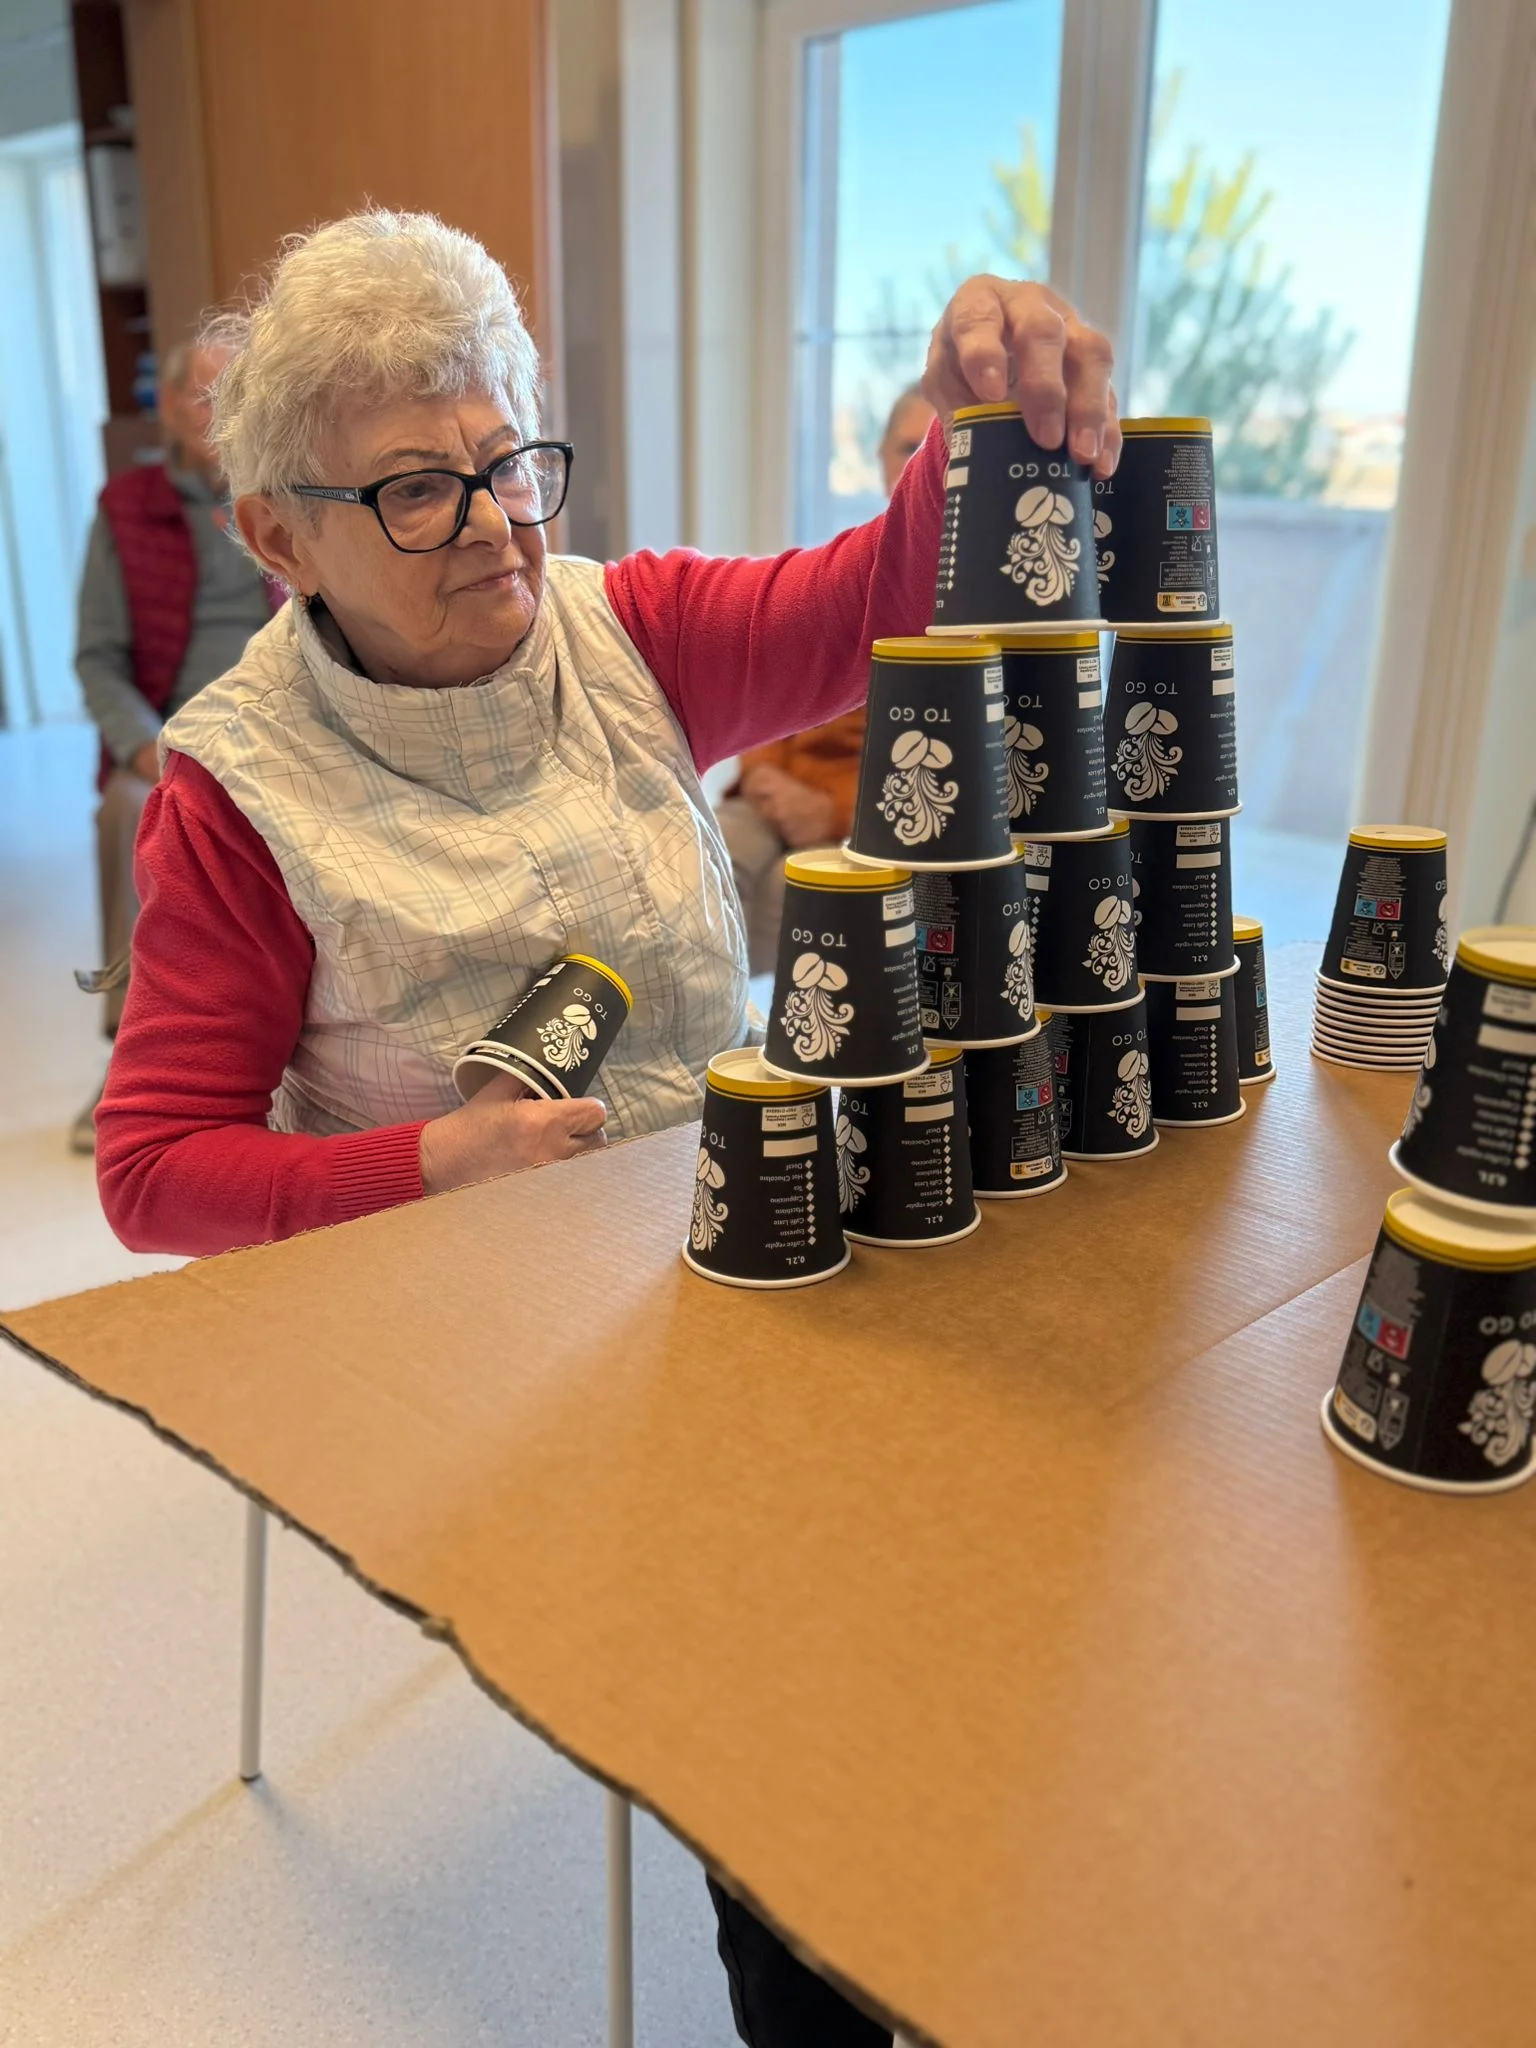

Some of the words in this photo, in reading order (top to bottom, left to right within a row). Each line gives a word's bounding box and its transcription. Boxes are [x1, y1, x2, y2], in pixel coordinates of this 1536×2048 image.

[1009, 463, 1039, 478] GO
[1047, 463, 1071, 478] TO
[1094, 481, 1114, 494] TO
[1125, 681, 1147, 695] GO
[1154, 682, 1178, 695] TO
[1017, 695, 1043, 708] TO
[888, 706, 915, 722] GO
[924, 708, 950, 723] TO
[1089, 877, 1111, 891] GO
[1117, 874, 1130, 887] TO
[1003, 902, 1021, 916] GO
[791, 928, 813, 944] GO
[820, 933, 847, 948] TO
[1174, 941, 1191, 949] regular
[573, 987, 592, 1002] GO
[594, 1003, 608, 1020] TO
[1112, 1034, 1132, 1046] GO
[1137, 1028, 1147, 1041] TO
[850, 1100, 868, 1116] TO
[925, 1127, 941, 1135] Decaf
[709, 1132, 726, 1149] TO
[784, 1163, 802, 1171] Decaf
[759, 1175, 789, 1183] Chocolate
[791, 1174, 802, 1182] Hot
[905, 1201, 925, 1209] regular
[780, 1228, 804, 1237] Espresso
[765, 1240, 784, 1249] regular
[786, 1240, 804, 1248] Coffee
[1479, 1316, 1515, 1336] GO
